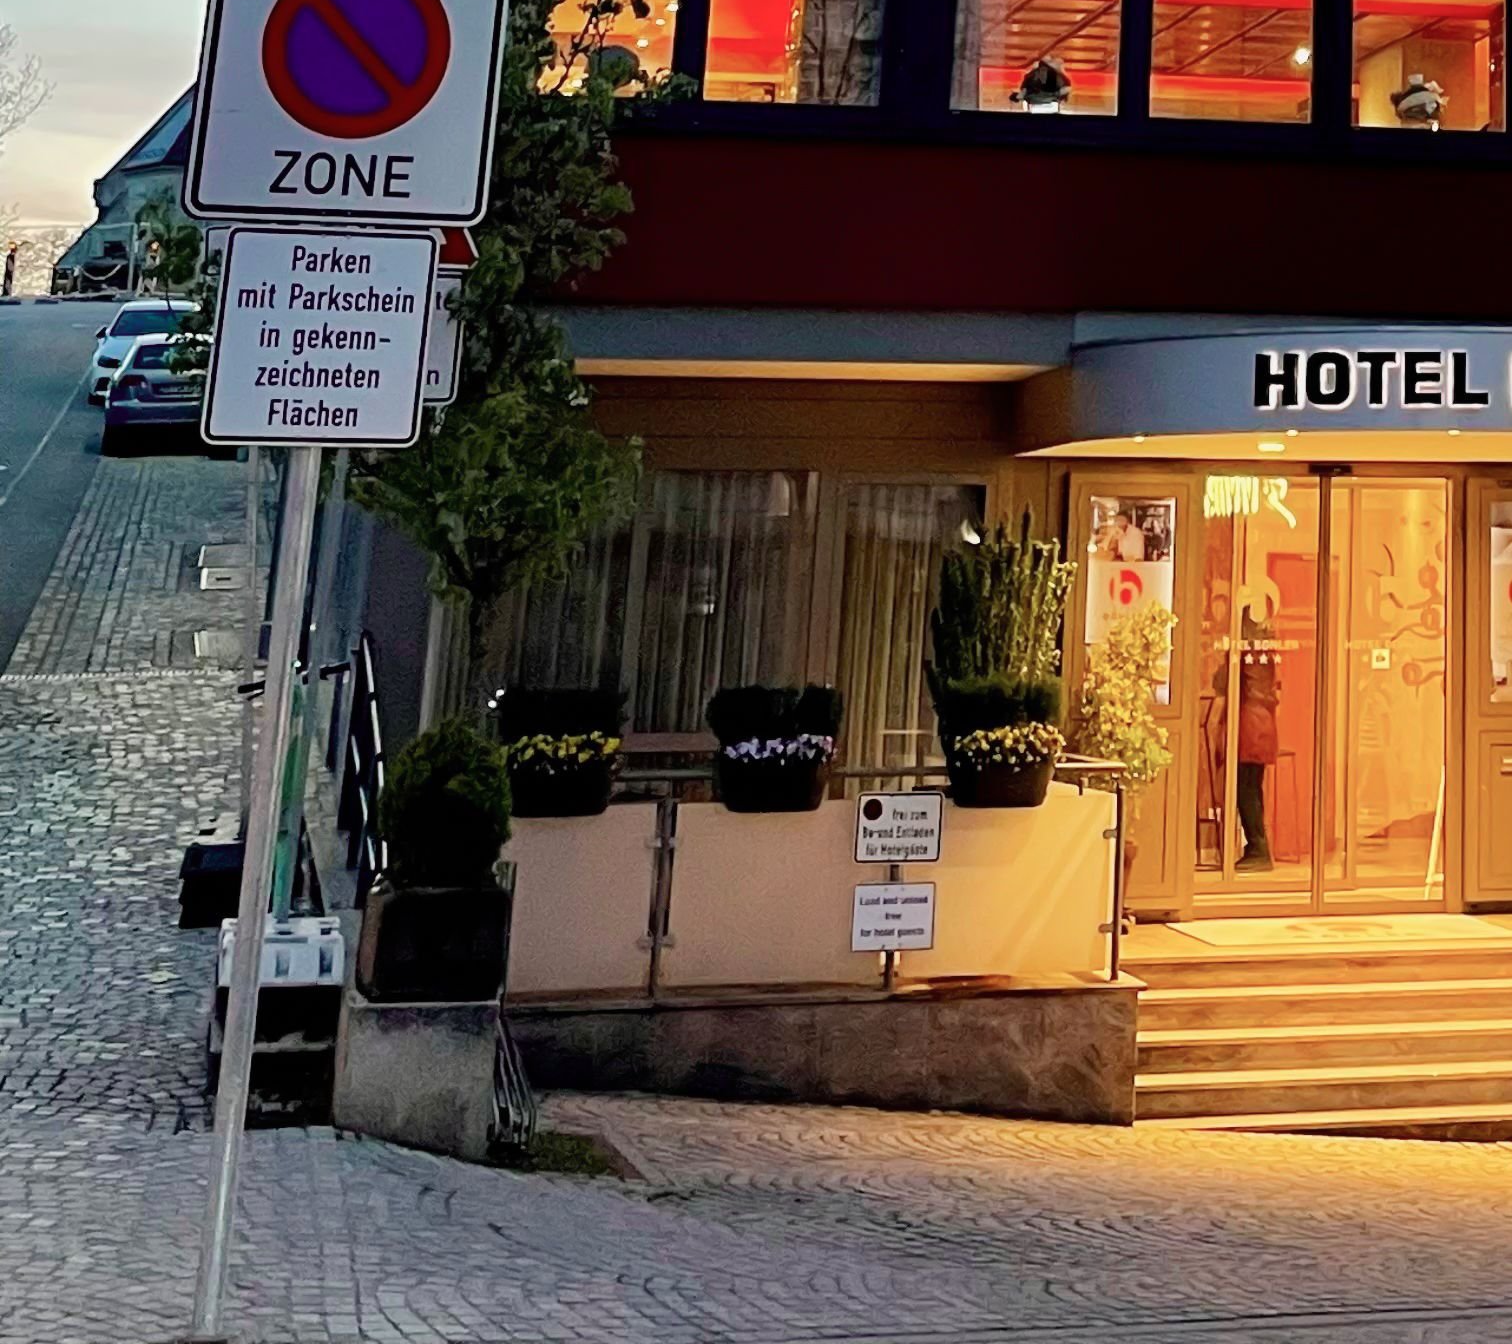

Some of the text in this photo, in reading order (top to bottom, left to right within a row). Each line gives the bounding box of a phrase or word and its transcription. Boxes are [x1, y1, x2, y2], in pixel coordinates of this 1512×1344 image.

[268, 149, 415, 199] ZONE
[291, 245, 371, 274] Parken
[237, 281, 277, 309] mit
[288, 282, 415, 314] Parkschein
[259, 319, 391, 356] in gekenn-
[254, 359, 380, 389] zeichneten
[1254, 350, 1489, 408] HOTEL
[267, 397, 359, 428] Flächen
